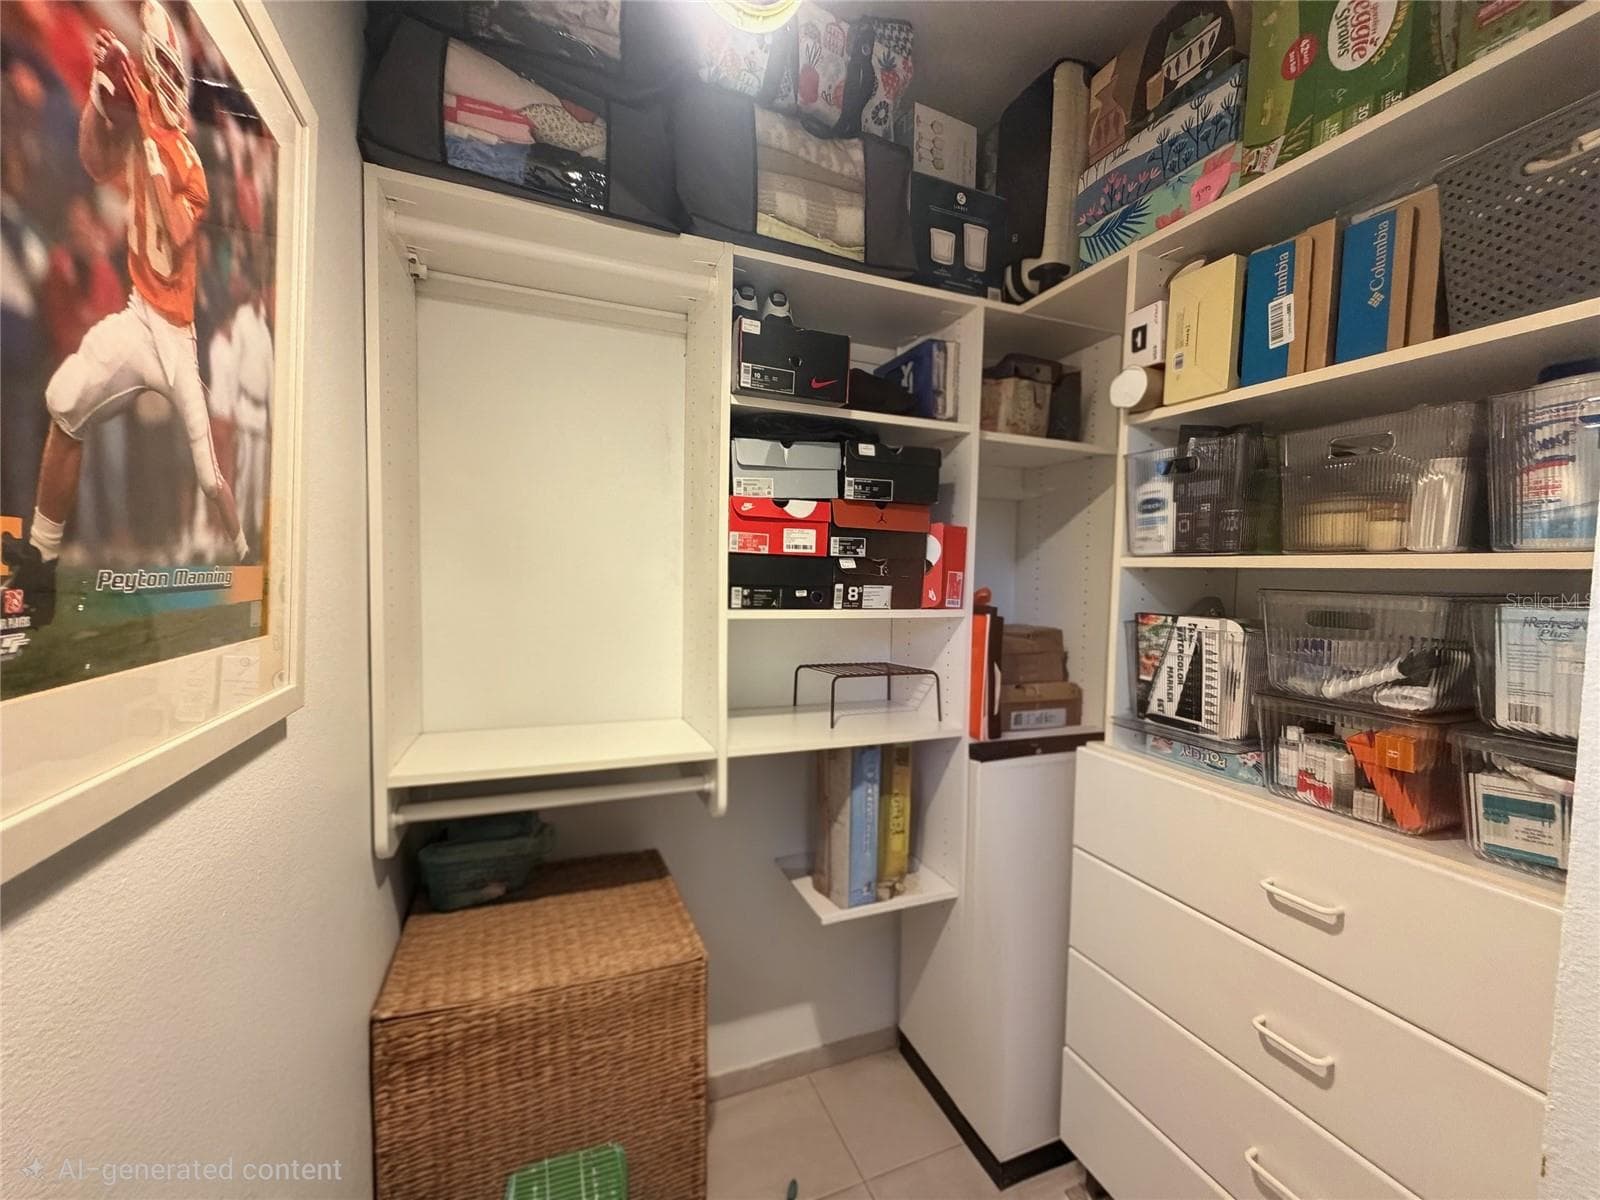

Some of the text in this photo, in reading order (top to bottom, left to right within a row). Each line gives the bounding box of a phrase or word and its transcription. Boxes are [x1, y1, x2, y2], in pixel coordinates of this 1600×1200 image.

[1335, 8, 1350, 59] Straws
[1350, 0, 1369, 62] eggie
[1273, 251, 1289, 300] lumbia
[1369, 220, 1389, 292] Columbia
[96, 566, 233, 593] Peyton Manning
[1176, 626, 1184, 686] WATERCOLOR
[1166, 665, 1174, 703] MARKER
